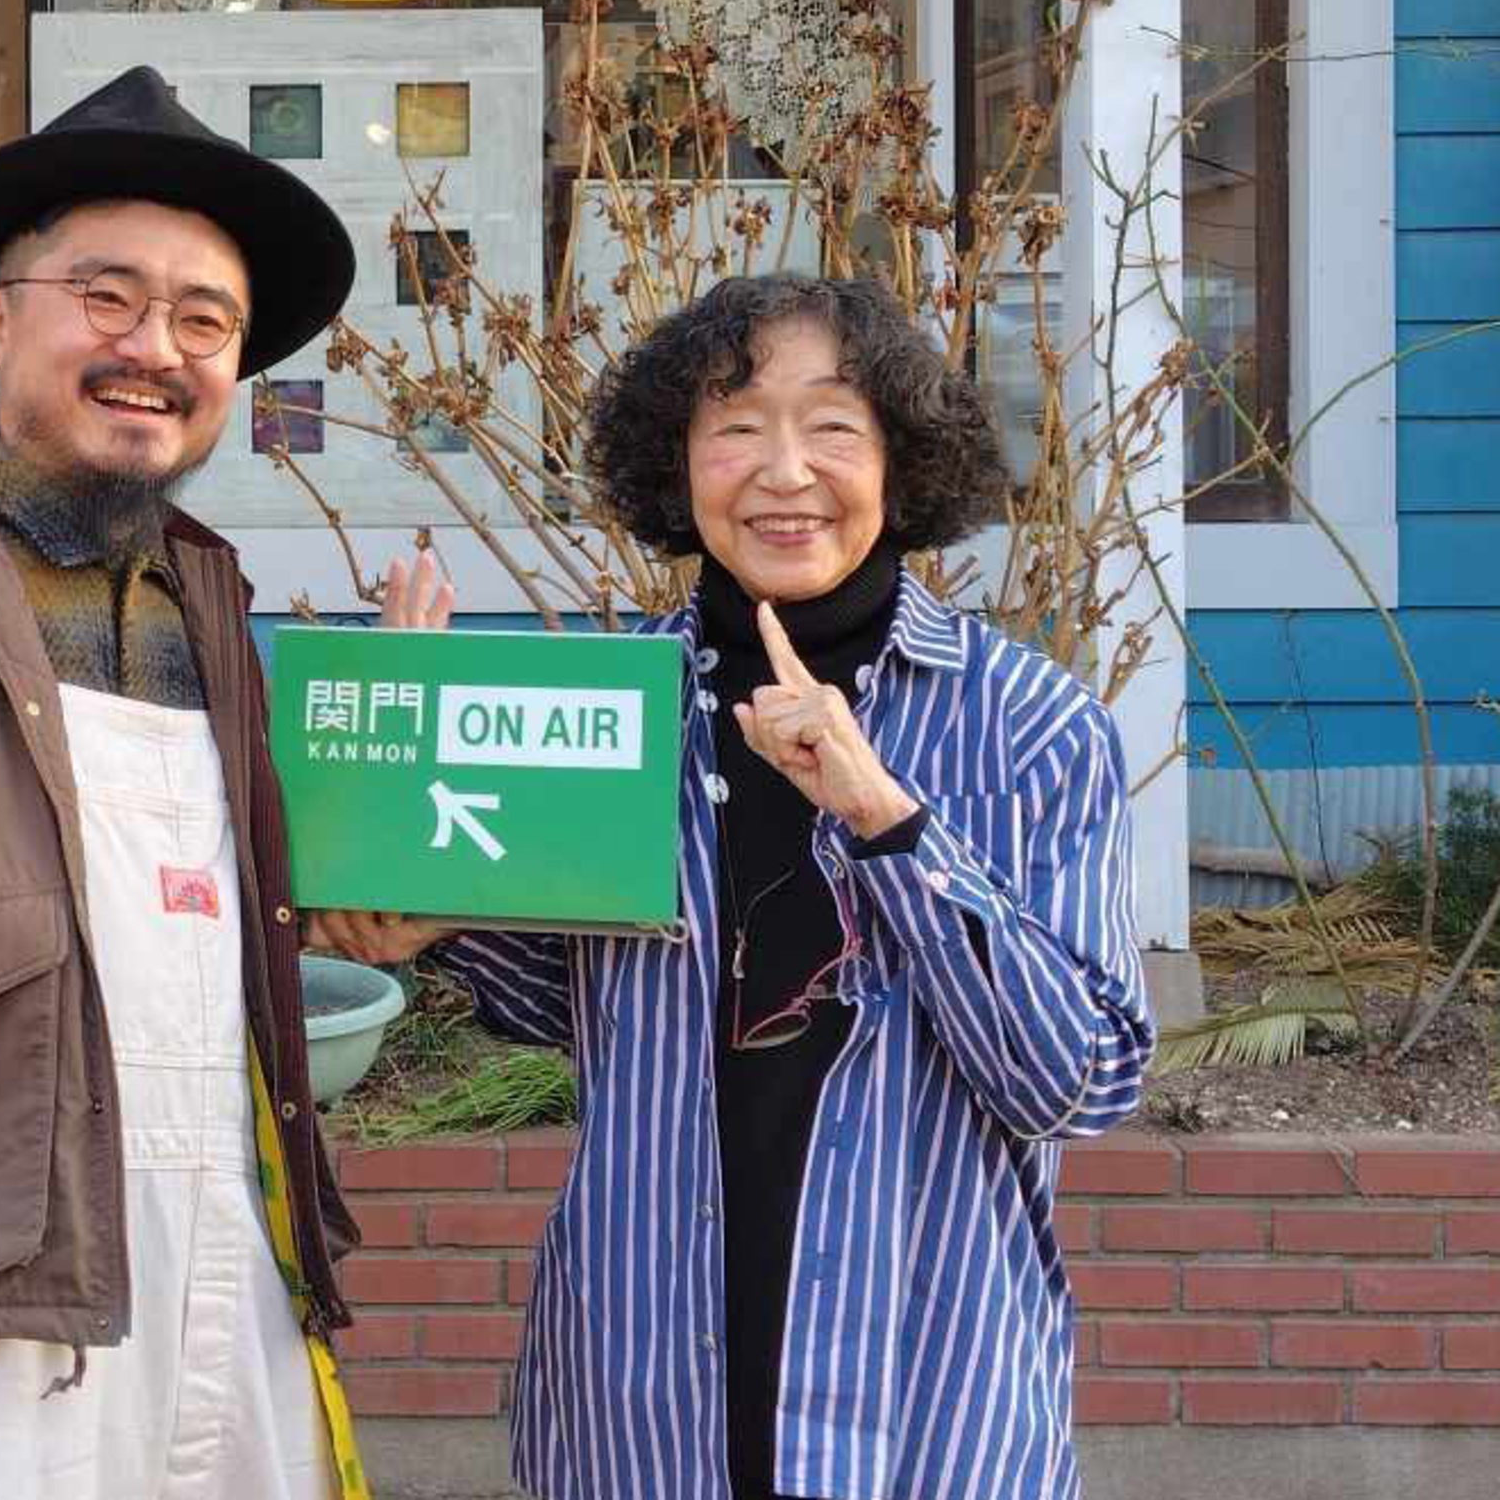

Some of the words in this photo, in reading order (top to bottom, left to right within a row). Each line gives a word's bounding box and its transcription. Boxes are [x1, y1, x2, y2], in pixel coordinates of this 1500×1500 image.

[305, 679, 424, 734] 関門
[458, 702, 524, 747] ON
[541, 706, 619, 750] AIR
